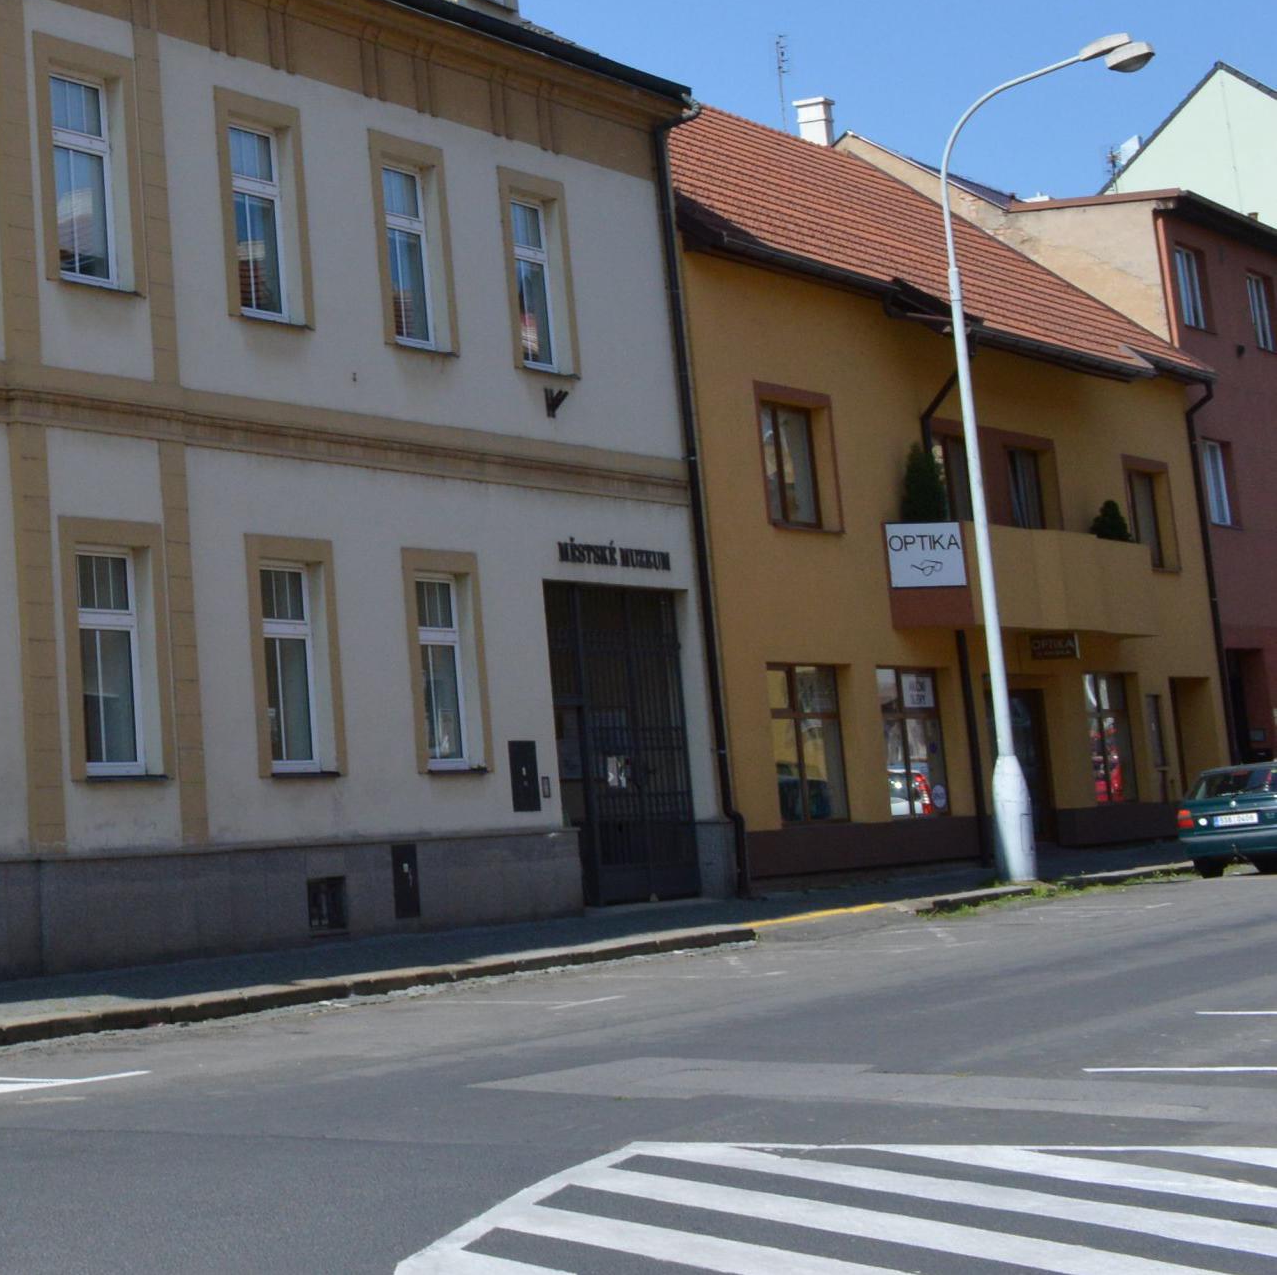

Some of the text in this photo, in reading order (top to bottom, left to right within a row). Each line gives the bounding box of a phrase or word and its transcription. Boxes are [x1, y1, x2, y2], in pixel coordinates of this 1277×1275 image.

[557, 536, 671, 571] MĚSTSKÉ MUZEUM
[888, 534, 961, 552] OPTIKA
